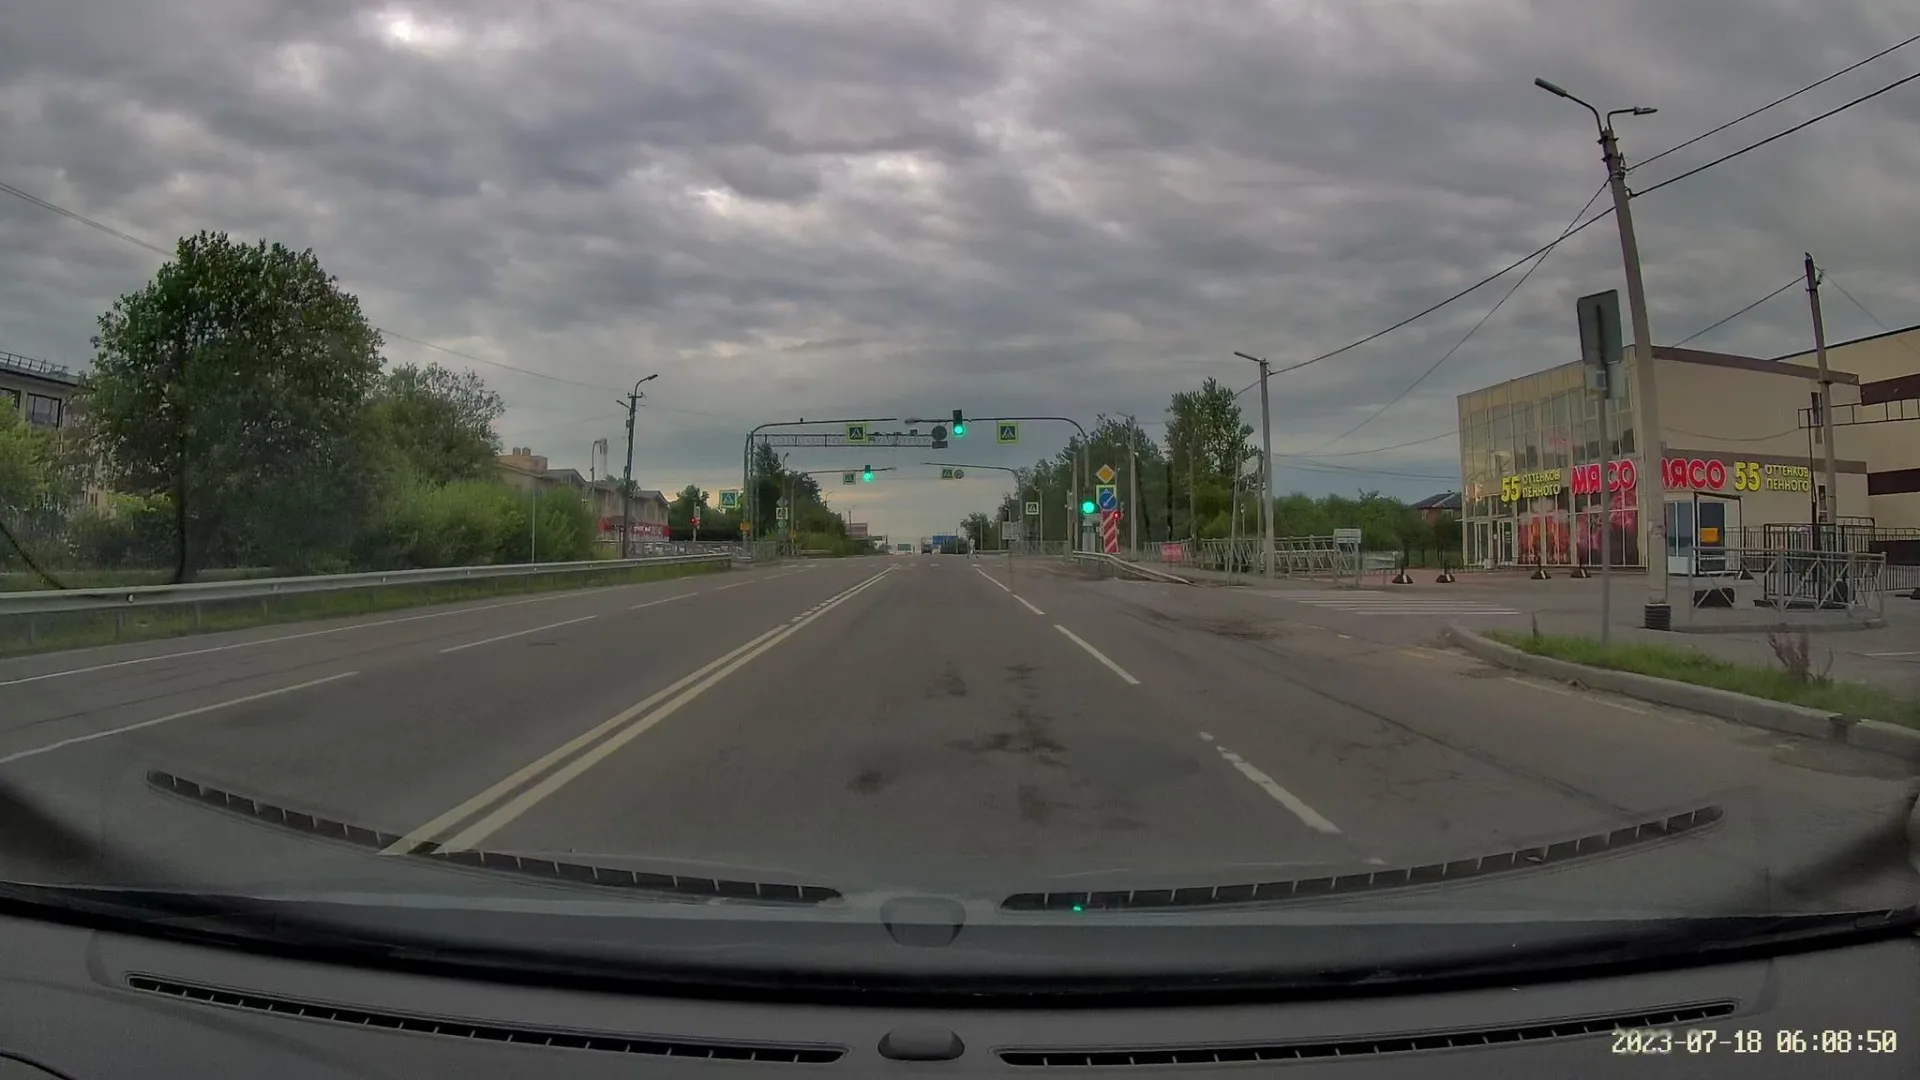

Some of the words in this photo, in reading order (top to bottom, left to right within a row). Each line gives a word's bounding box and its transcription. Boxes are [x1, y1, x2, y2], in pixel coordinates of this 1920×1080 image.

[1522, 468, 1561, 485] ОТТЕНКОВ
[1572, 459, 1636, 495] МЯСО
[1734, 461, 1761, 491] 55
[1765, 464, 1809, 479] ОТТЕНКОВ
[1501, 475, 1521, 502] 55
[1522, 483, 1561, 499] ПЕННОГО
[1766, 478, 1809, 492] ПЕННОГО
